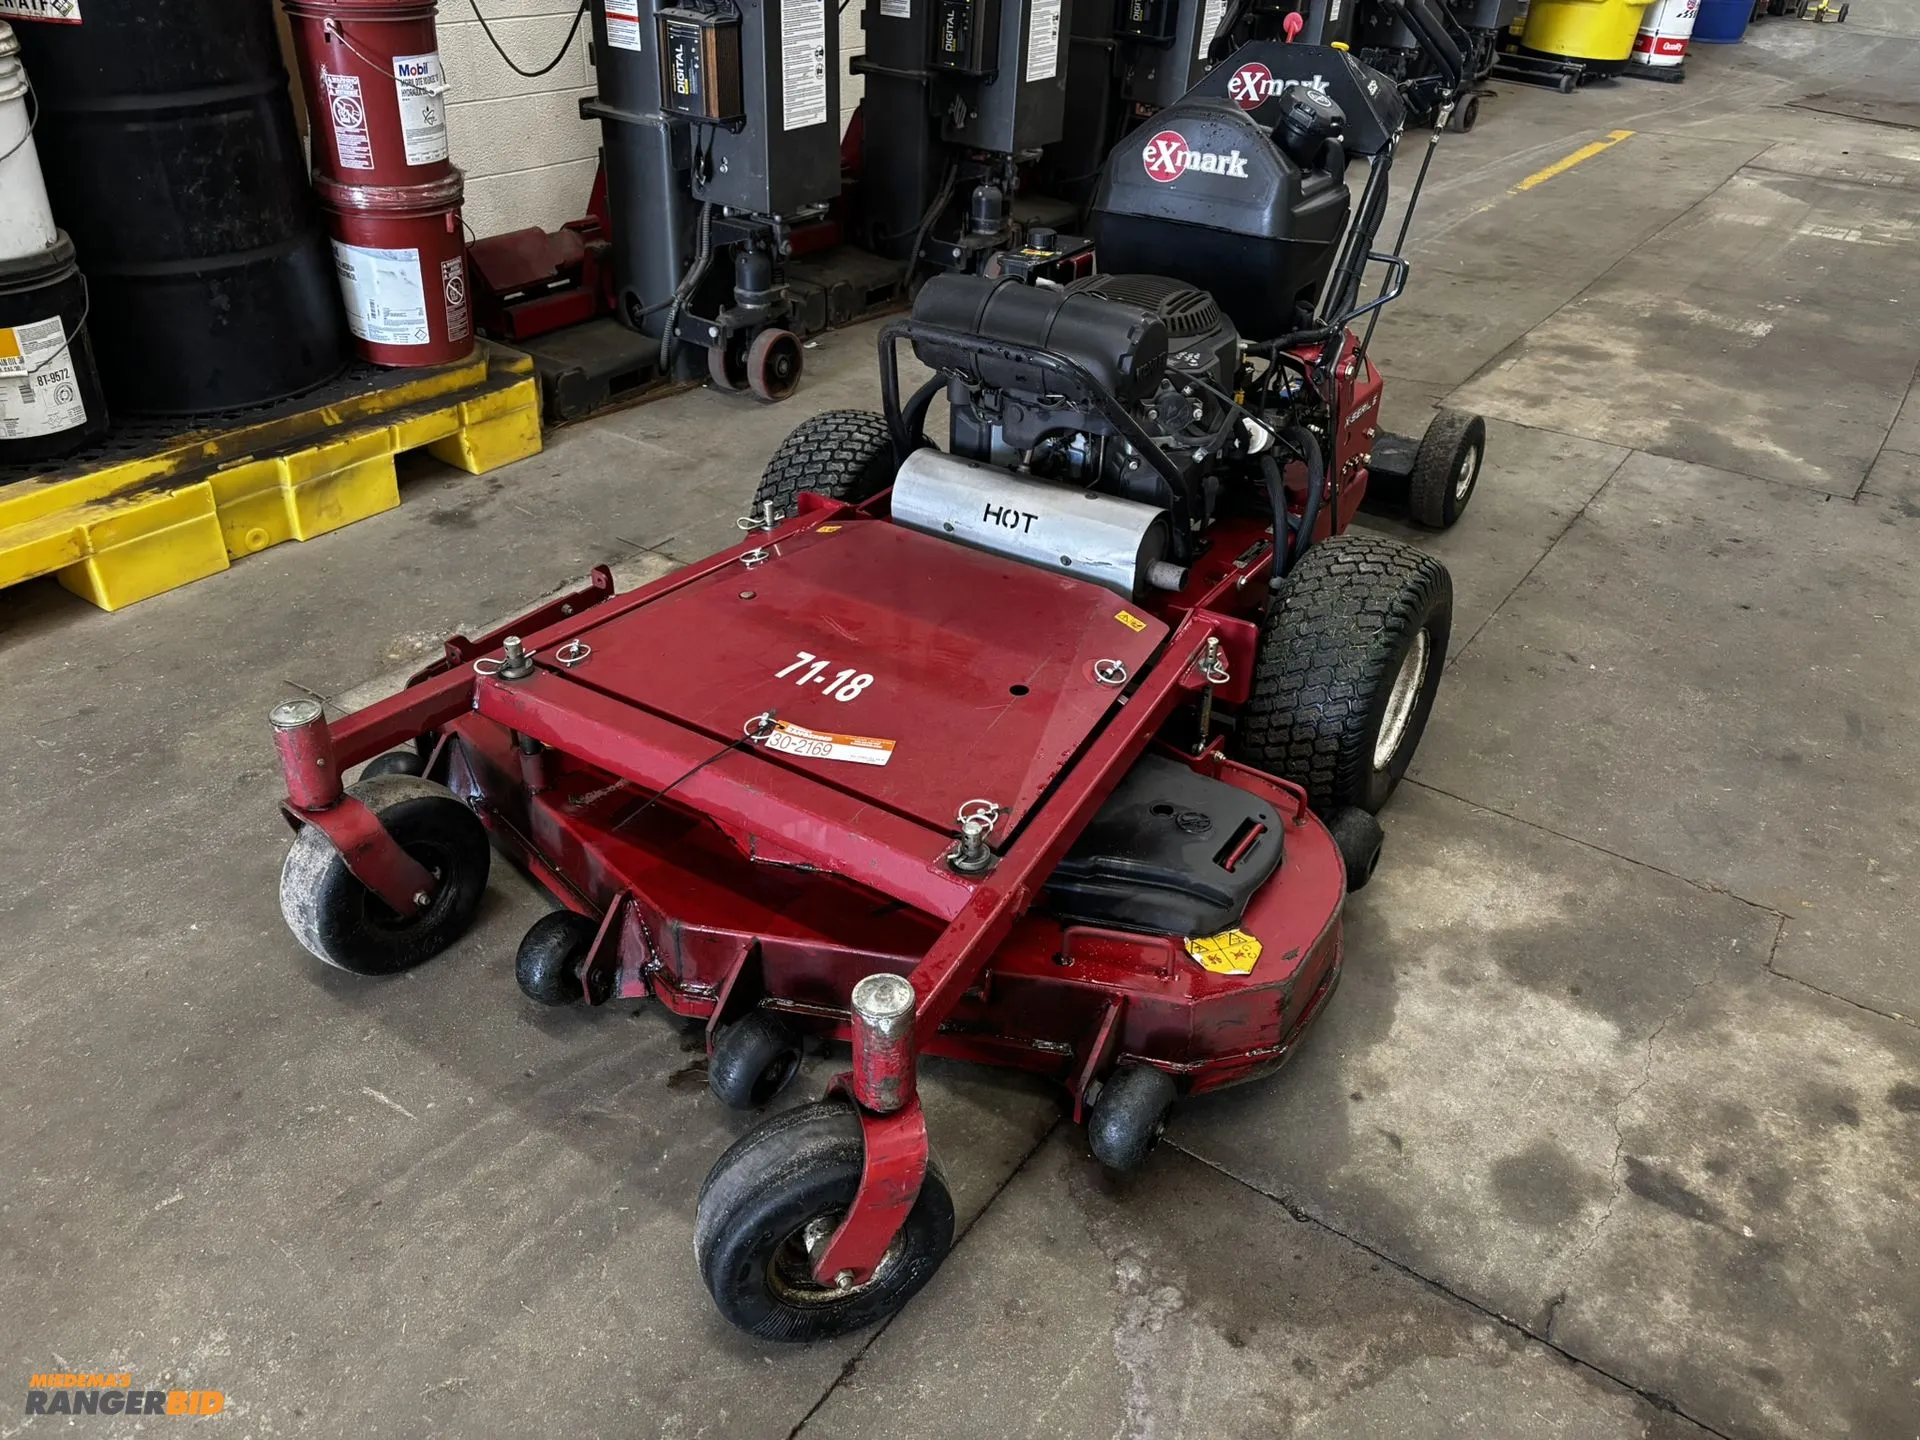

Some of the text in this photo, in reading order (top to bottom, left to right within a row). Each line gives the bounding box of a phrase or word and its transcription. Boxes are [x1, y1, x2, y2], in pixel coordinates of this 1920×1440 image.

[945, 9, 955, 52] DIGITAL
[398, 62, 429, 77] Mobil
[675, 43, 686, 95] DIGITAL
[1142, 139, 1249, 179] eXmark
[36, 367, 70, 387] 8T-9572
[982, 502, 1039, 534] HOT
[774, 651, 875, 702] 71-18
[769, 732, 833, 757] 30-2169
